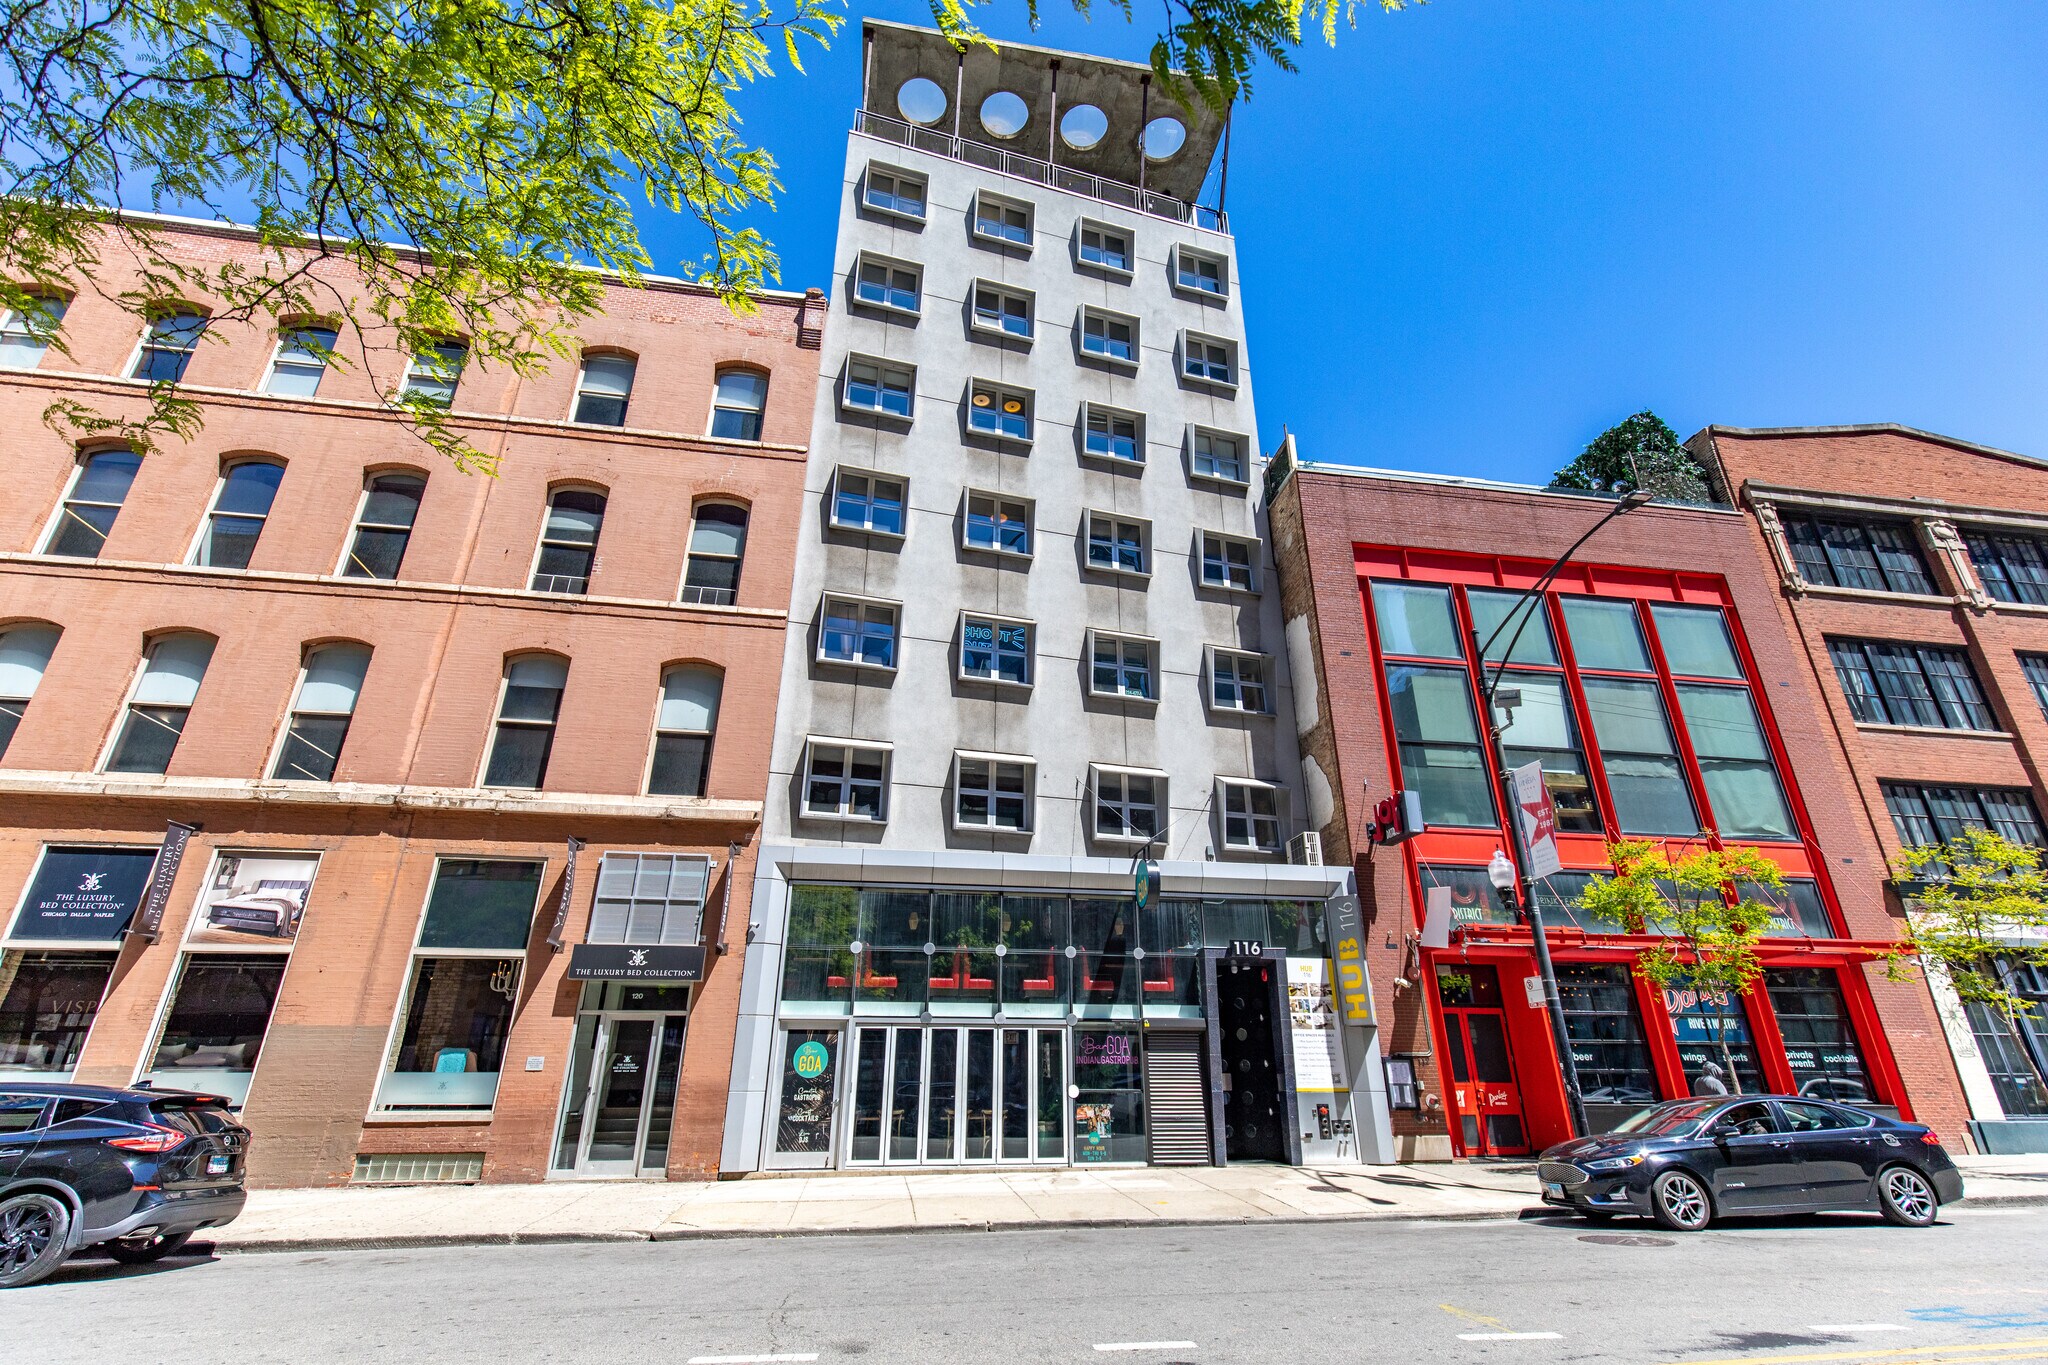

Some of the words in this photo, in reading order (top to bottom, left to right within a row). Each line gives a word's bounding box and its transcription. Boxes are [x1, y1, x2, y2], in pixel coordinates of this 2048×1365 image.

[965, 626, 1011, 642] SHOT
[149, 893, 161, 915] THE
[157, 843, 175, 888] LUXURY
[150, 910, 162, 931] BED
[160, 833, 186, 905] COLLECTION
[554, 851, 573, 927] VISPRING
[77, 894, 115, 902] LUXURY
[1338, 902, 1355, 931] 116
[1234, 941, 1260, 955] 116
[1339, 937, 1368, 1019] HUB
[1080, 1034, 1107, 1054] Bar
[1106, 1036, 1131, 1056] GOA
[798, 1055, 821, 1072] GOA
[1076, 1055, 1099, 1064] INDIAN
[1100, 1055, 1138, 1064] GASTROPUB
[1573, 1052, 1593, 1061] beer
[1682, 1053, 1707, 1063] wings
[1785, 1051, 1814, 1061] private
[1824, 1055, 1859, 1063] cocktails
[1788, 1060, 1816, 1068] events
